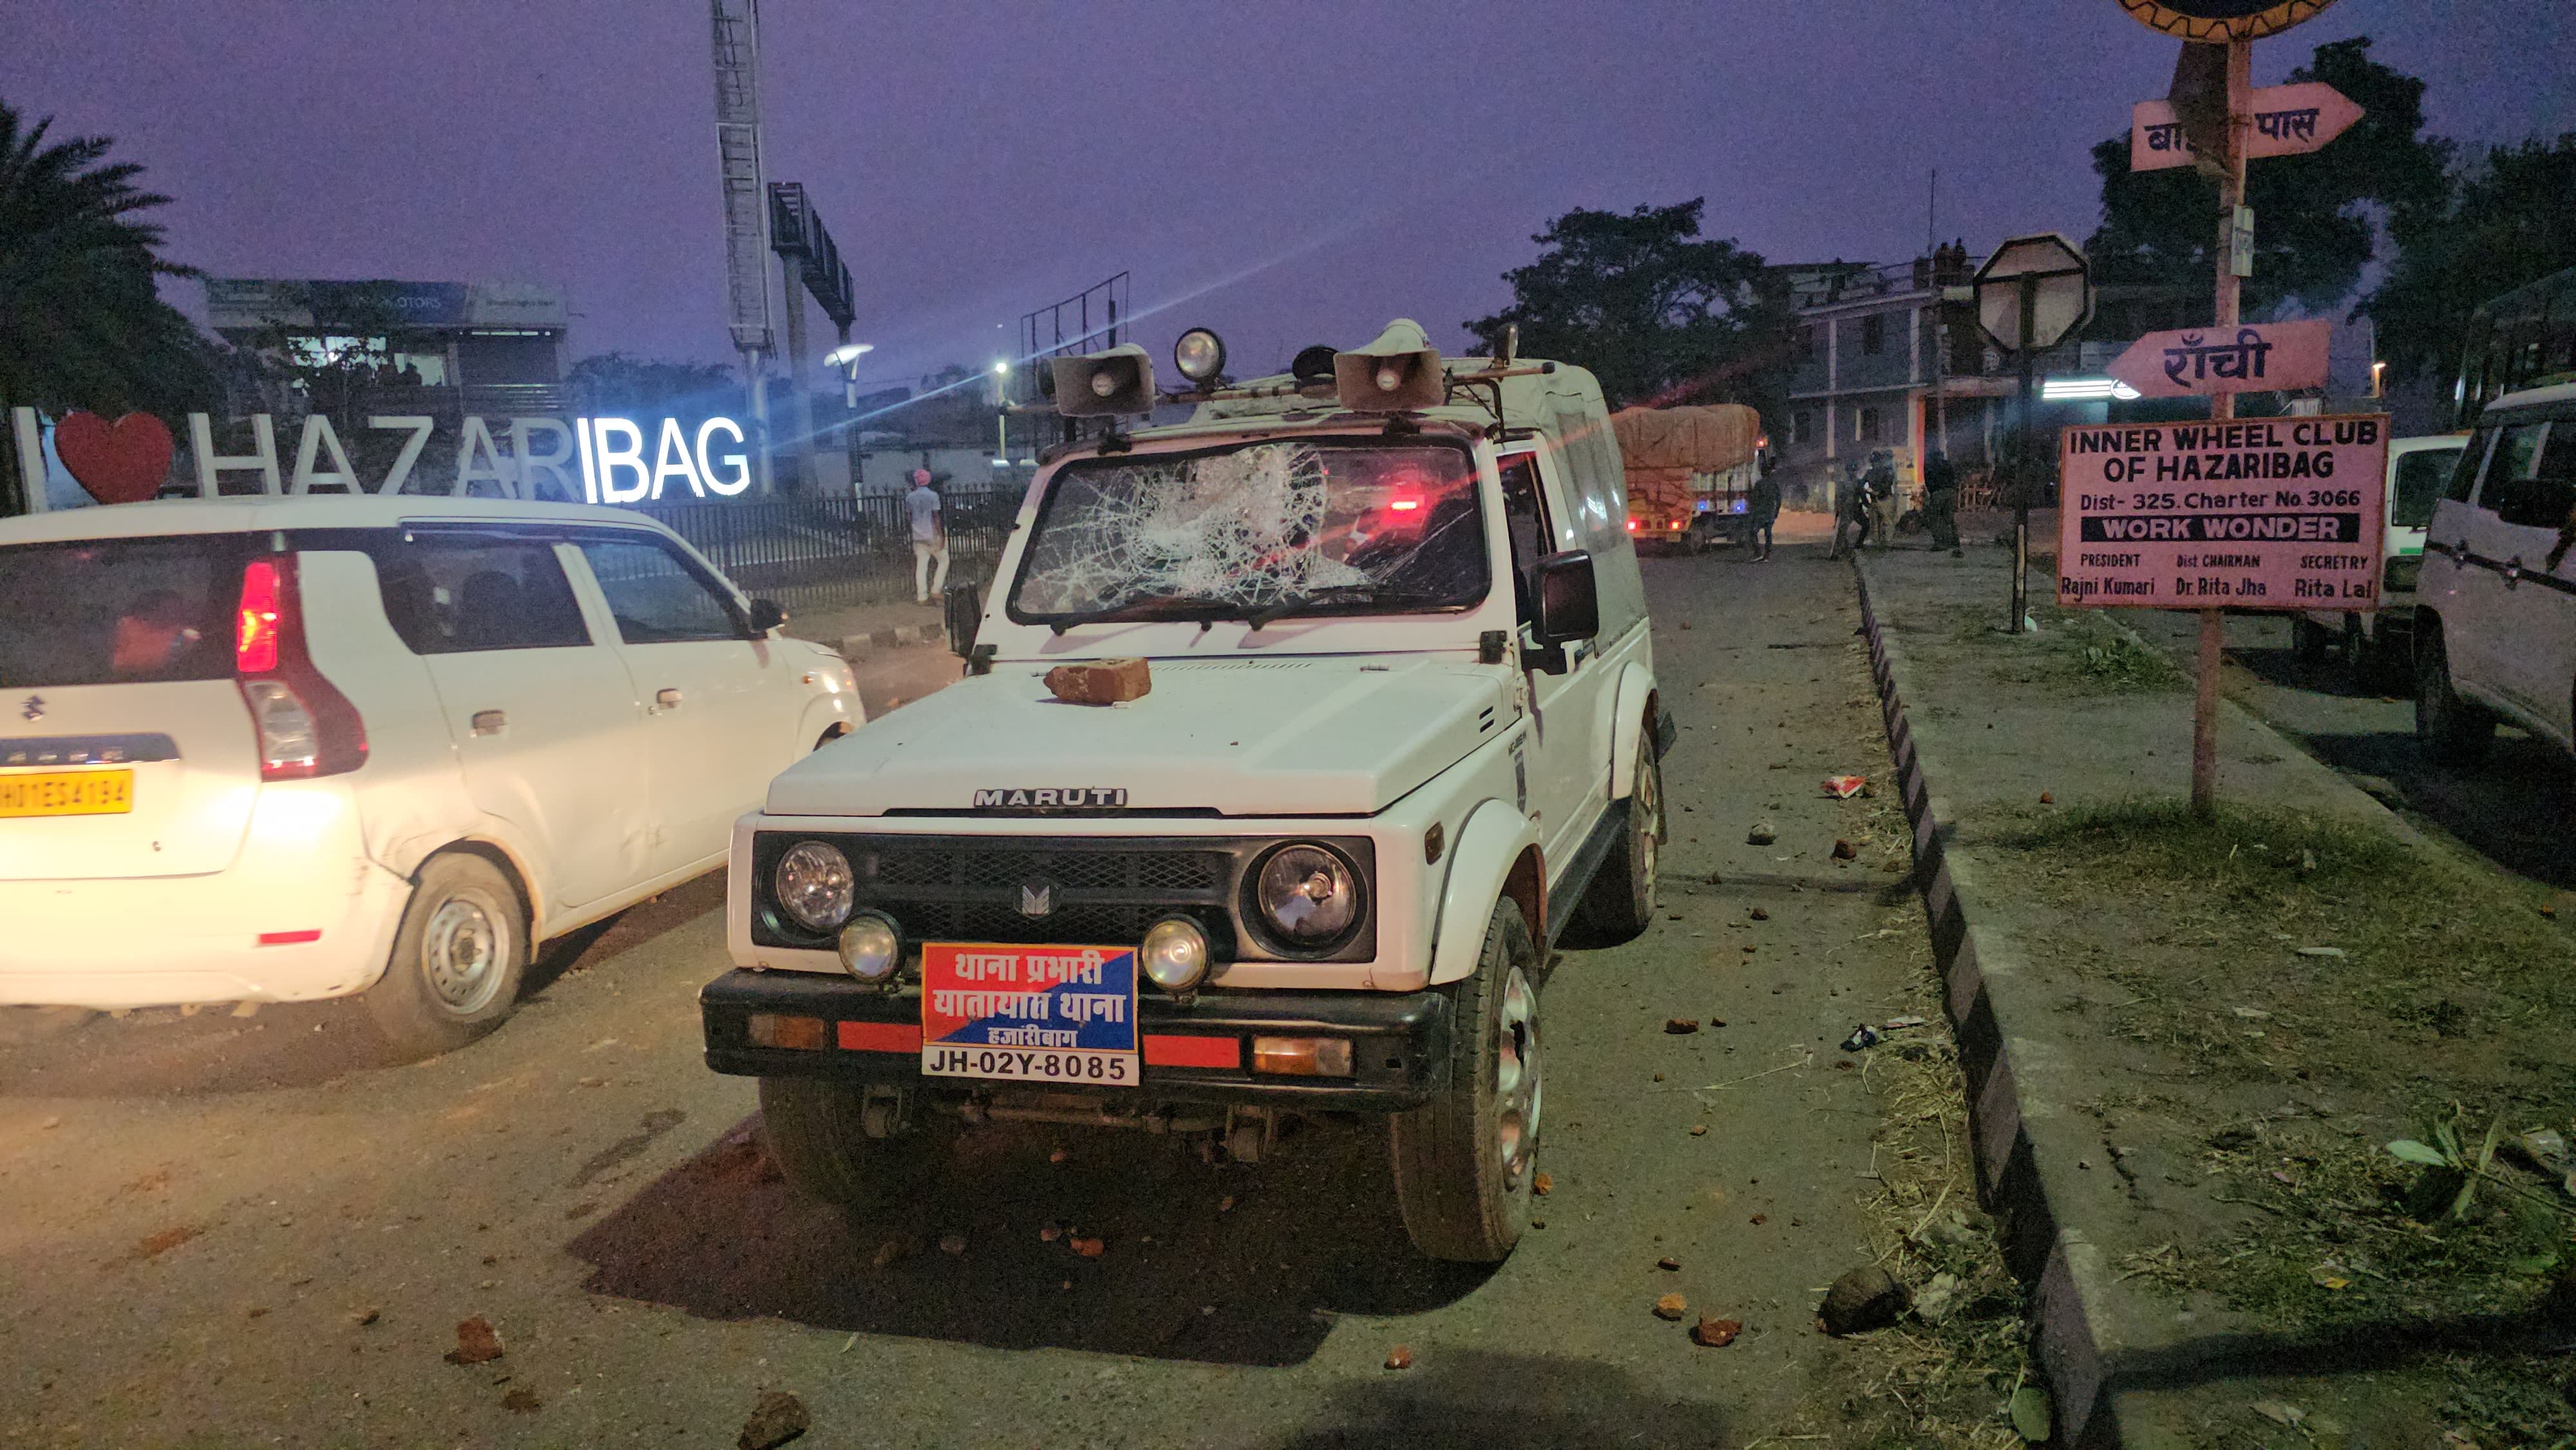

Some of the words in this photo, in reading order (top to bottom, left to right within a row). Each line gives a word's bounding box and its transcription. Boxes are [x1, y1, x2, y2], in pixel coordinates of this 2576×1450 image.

[2070, 429, 2162, 453] INNER
[2173, 424, 2284, 450] WHEEL
[2293, 421, 2378, 446] CLUB
[188, 413, 751, 505] HAZARIBAG
[2103, 456, 2146, 482] OF
[2157, 451, 2334, 482] HAZARIBAG
[2102, 518, 2192, 539] WORK
[2202, 516, 2340, 540] WONDER
[2080, 553, 2141, 567] PRESIDENT
[2202, 554, 2260, 568] CHAIRMAN
[2300, 554, 2368, 570] SECRETRY
[2061, 577, 2099, 603] Rajni
[2103, 577, 2155, 595] Kumari
[2197, 577, 2230, 596] Rita
[2235, 577, 2267, 596] Jha
[2295, 578, 2335, 598] Rita
[2342, 579, 2374, 599] Lal
[974, 789, 1125, 806] MARUTI
[955, 953, 1019, 982] थाना
[1026, 950, 1105, 984] प्रभारी
[932, 989, 1052, 1020] यातायात
[1059, 993, 1127, 1022] थाना
